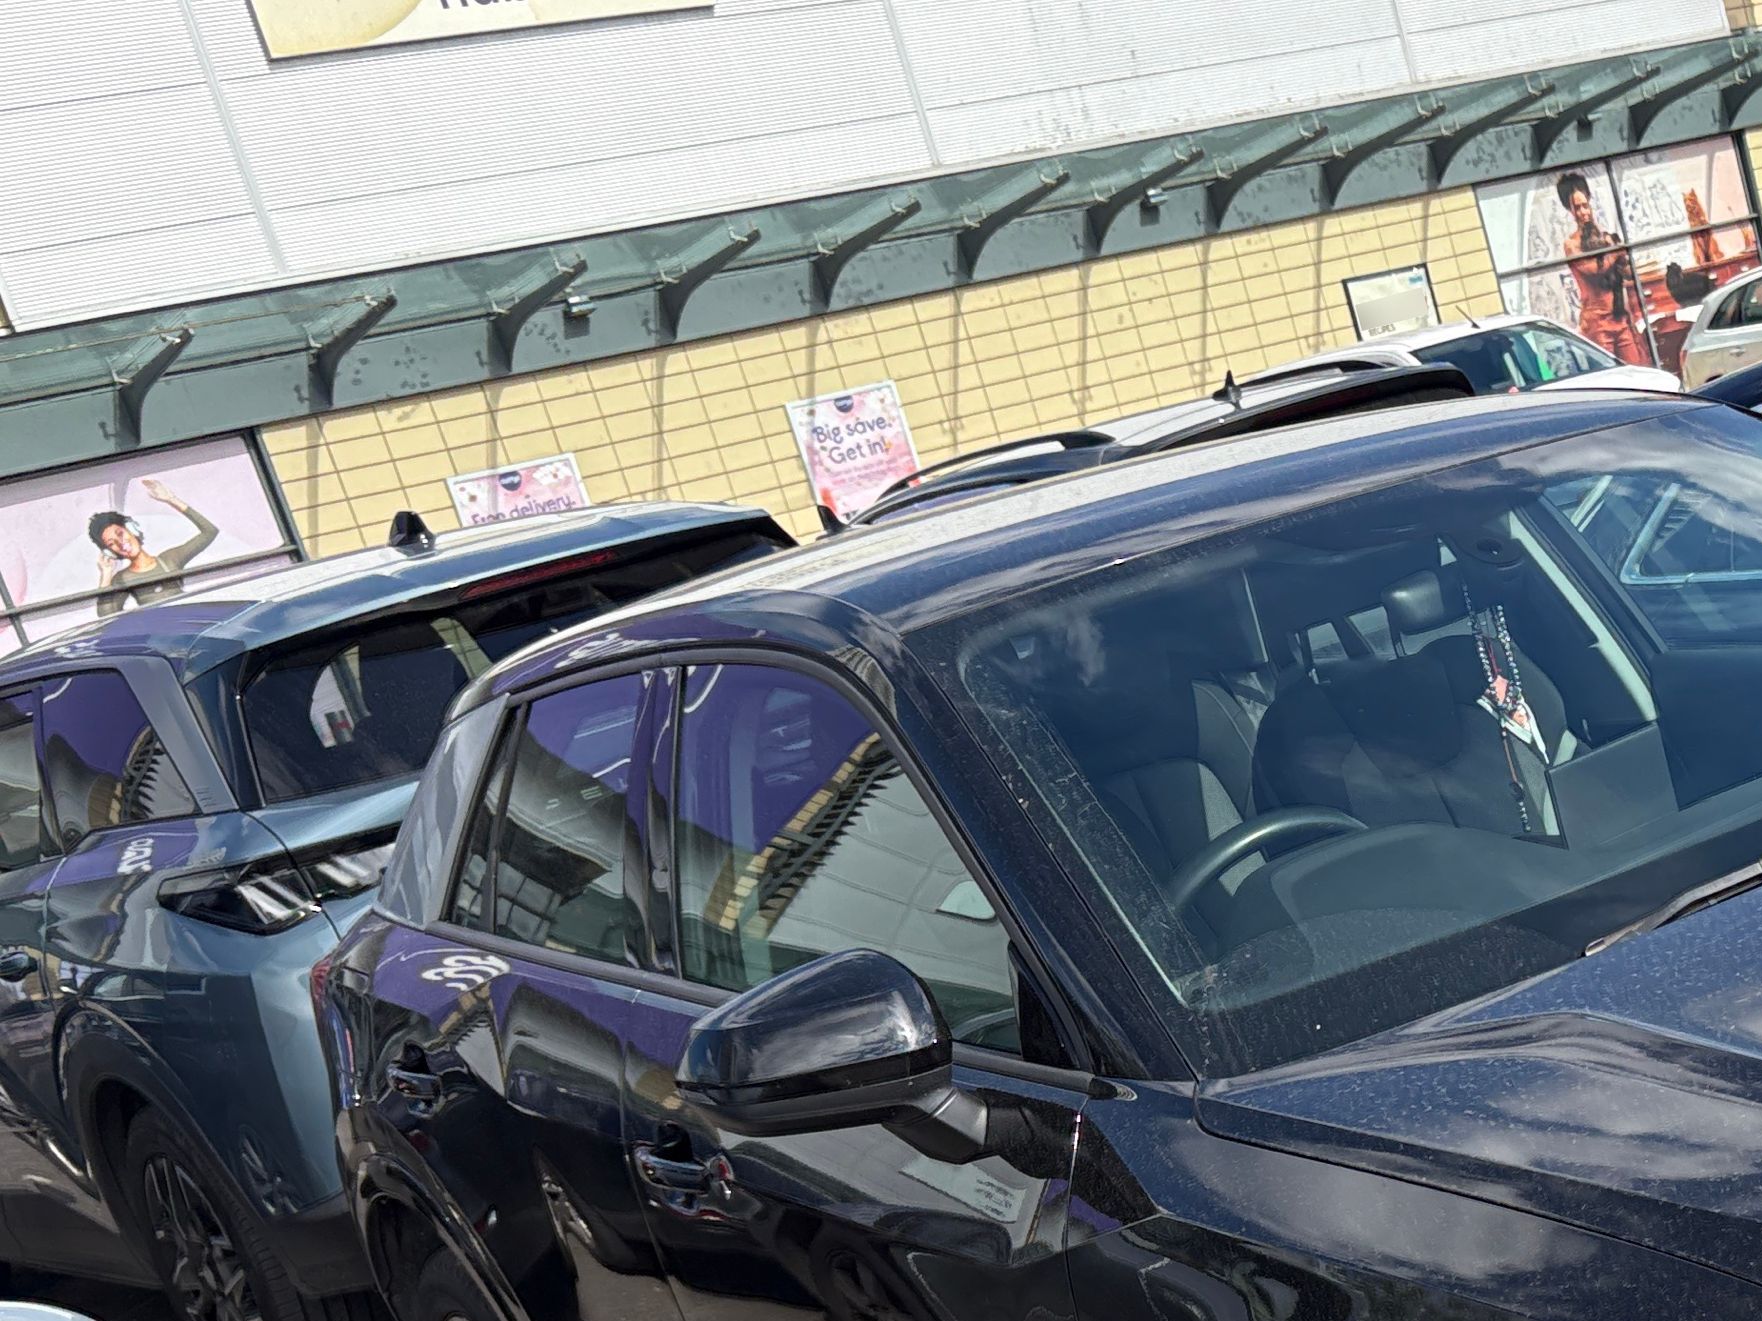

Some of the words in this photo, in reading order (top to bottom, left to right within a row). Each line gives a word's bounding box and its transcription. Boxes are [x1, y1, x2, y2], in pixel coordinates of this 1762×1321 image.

[815, 424, 844, 444] Big
[846, 417, 892, 436] save.
[828, 442, 866, 464] Get
[868, 436, 889, 454] in!
